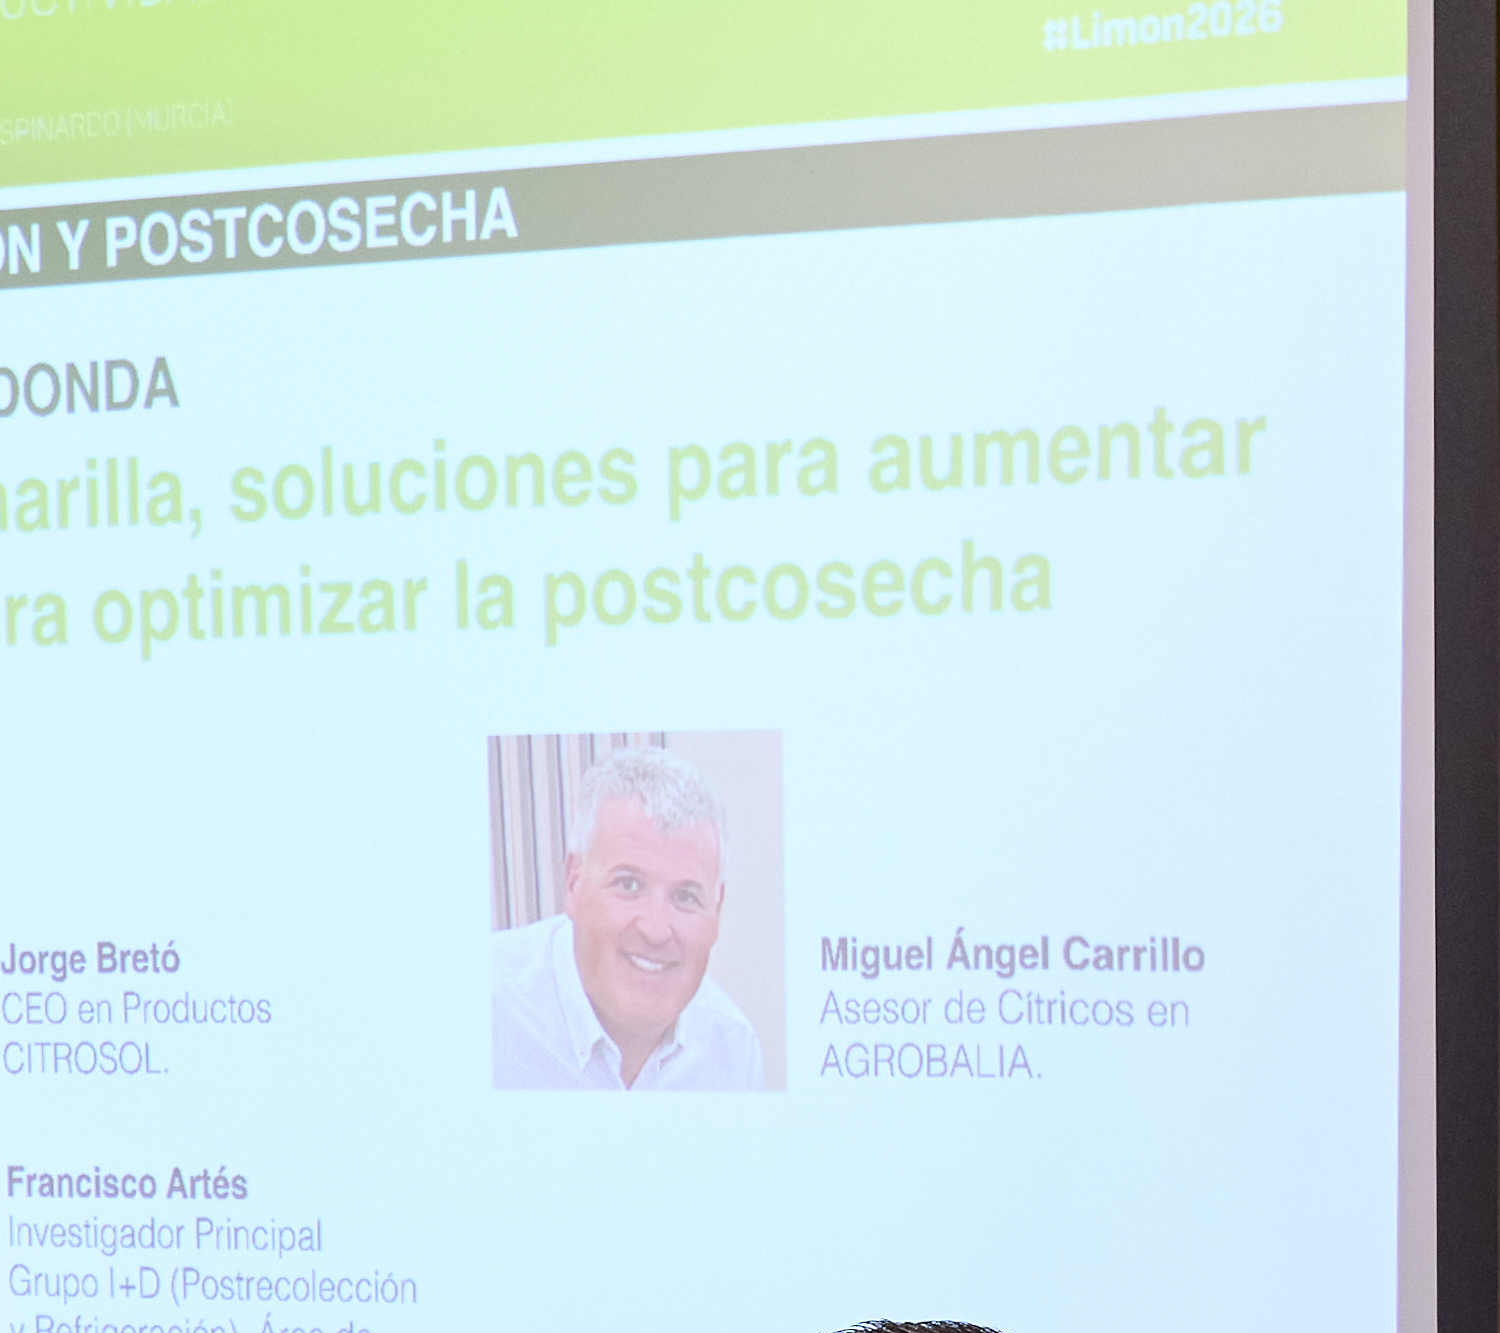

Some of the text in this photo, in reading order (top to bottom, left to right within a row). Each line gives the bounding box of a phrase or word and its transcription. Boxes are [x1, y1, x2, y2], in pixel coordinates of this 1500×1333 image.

[1042, 0, 1284, 51] #Limon2026
[55, 221, 88, 274] Y
[105, 187, 518, 269] POSTCOSECHA
[229, 438, 637, 524] soluciones
[666, 434, 839, 523] para
[867, 405, 1267, 494] aumentar
[92, 564, 427, 663] optimizar
[454, 556, 514, 630] la
[543, 539, 1052, 648] postcosecha
[0, 939, 181, 983] Jorge Bretó
[820, 926, 1206, 980] Miguel Ángel Carrillo
[1, 990, 273, 1025] CEO en Productos
[819, 988, 1190, 1028] Asesor de Cítricos en
[2, 1040, 170, 1075] CITROSOL.
[819, 1042, 1042, 1080] AGROBALIA.
[5, 1164, 249, 1200] Francisco Artés
[8, 1213, 323, 1259] Investigador Principal
[8, 1263, 418, 1307] Grupo I+D (Postrecolección
